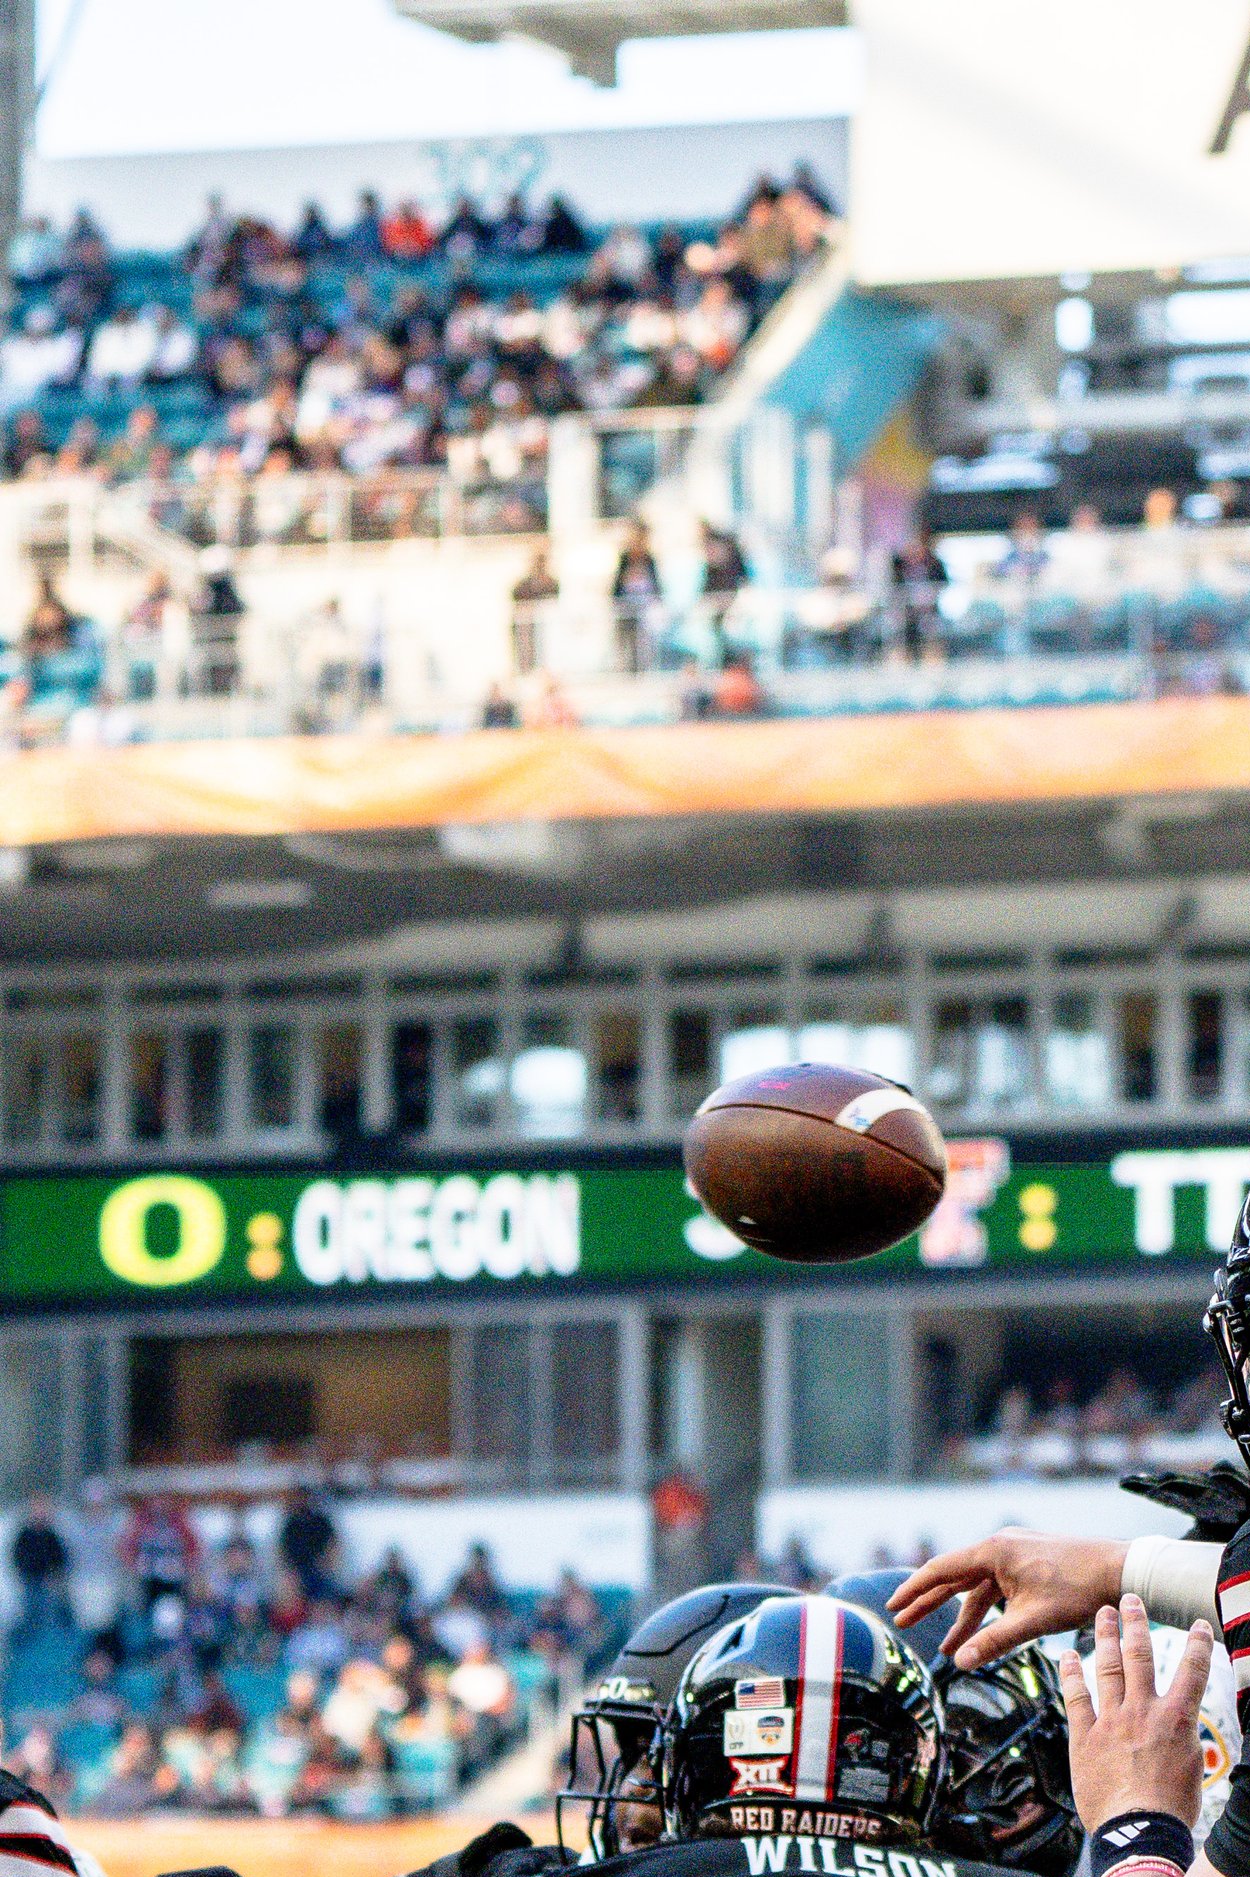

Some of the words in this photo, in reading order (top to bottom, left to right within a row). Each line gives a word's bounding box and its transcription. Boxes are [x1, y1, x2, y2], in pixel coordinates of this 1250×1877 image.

[292, 1173, 581, 1286] OREGON
[730, 1758, 795, 1796] XII
[730, 1806, 775, 1831] RED
